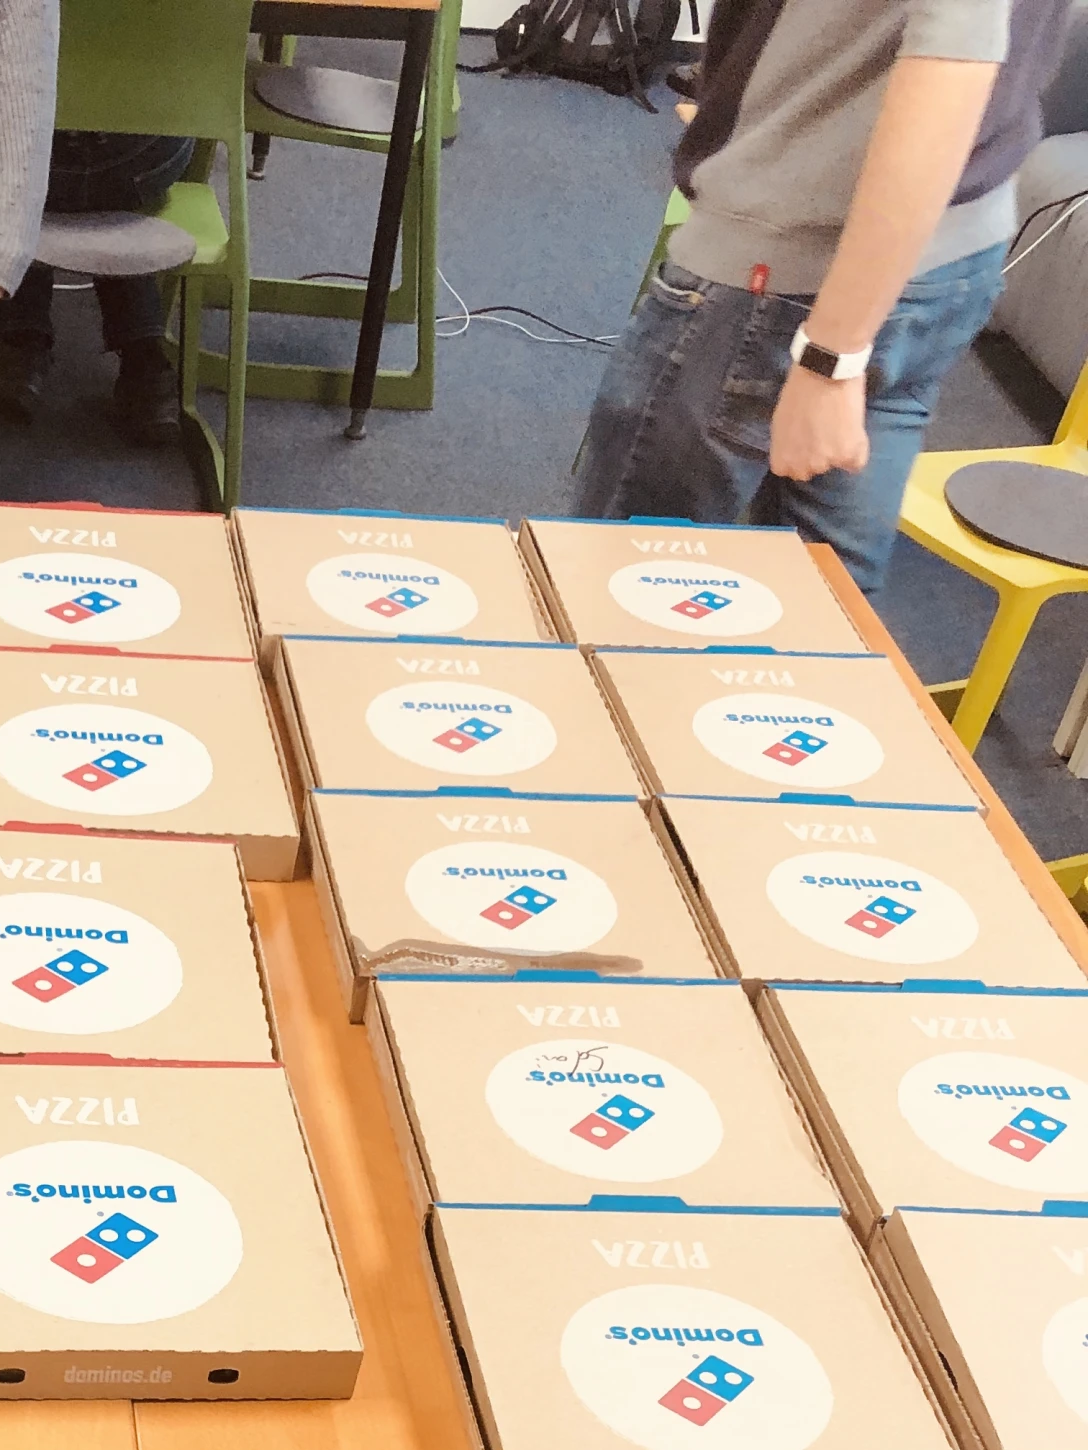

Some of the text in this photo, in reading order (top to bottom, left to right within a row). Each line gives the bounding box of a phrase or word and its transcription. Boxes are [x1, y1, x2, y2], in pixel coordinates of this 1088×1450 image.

[29, 526, 117, 548] PIZZA
[337, 529, 414, 548] PIZZA
[631, 539, 708, 556] PIZZA
[21, 571, 138, 589] Domino's
[341, 570, 440, 586] Domino's
[640, 576, 740, 589] Domino's
[396, 657, 481, 676] PIZZA
[40, 673, 139, 697] PIZZA
[711, 669, 796, 688] PIZZA
[402, 701, 513, 714] Domino's
[725, 713, 835, 727] Domino's
[35, 728, 164, 746] Domino's
[436, 813, 531, 834] PIZZA
[784, 821, 878, 844] PIZZA
[445, 866, 568, 881] Domino's
[802, 875, 923, 893] Domino's
[516, 1004, 622, 1028] PIZZA
[911, 1016, 1016, 1040] PIZZA
[529, 1069, 666, 1089] Domino's
[936, 1083, 1071, 1101] Domino's
[14, 1095, 140, 1126] PIZZA
[12, 1182, 178, 1205] Domino's
[592, 1239, 710, 1270] PIZZA
[608, 1325, 765, 1347] Domino's
[63, 1365, 173, 1384] dominos.de
